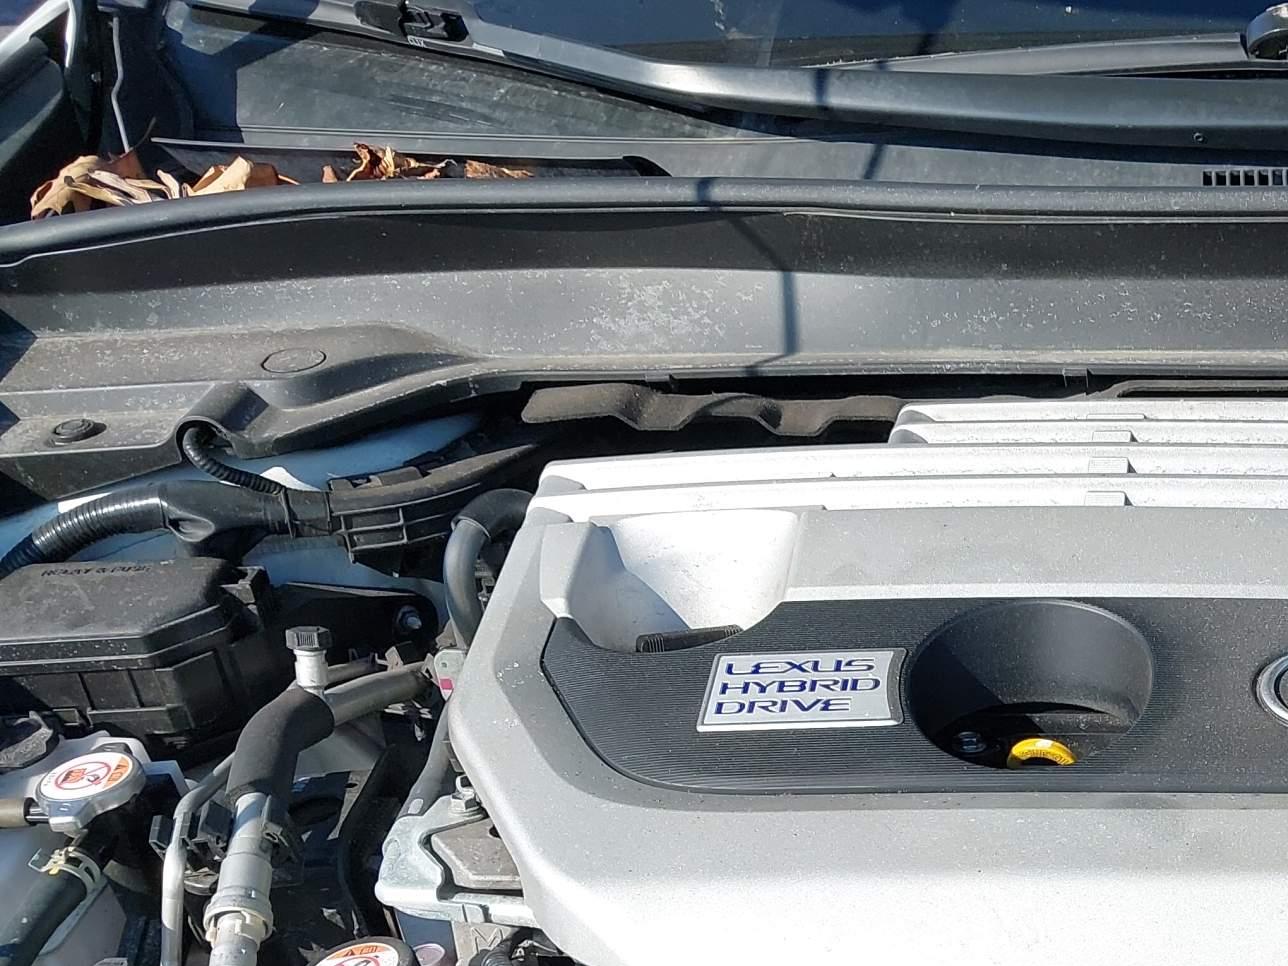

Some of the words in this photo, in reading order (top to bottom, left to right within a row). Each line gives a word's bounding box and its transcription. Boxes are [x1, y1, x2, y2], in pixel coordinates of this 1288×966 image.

[724, 657, 875, 676] LEXUS
[719, 678, 881, 695] HYBRID
[714, 697, 853, 715] DRIVE
